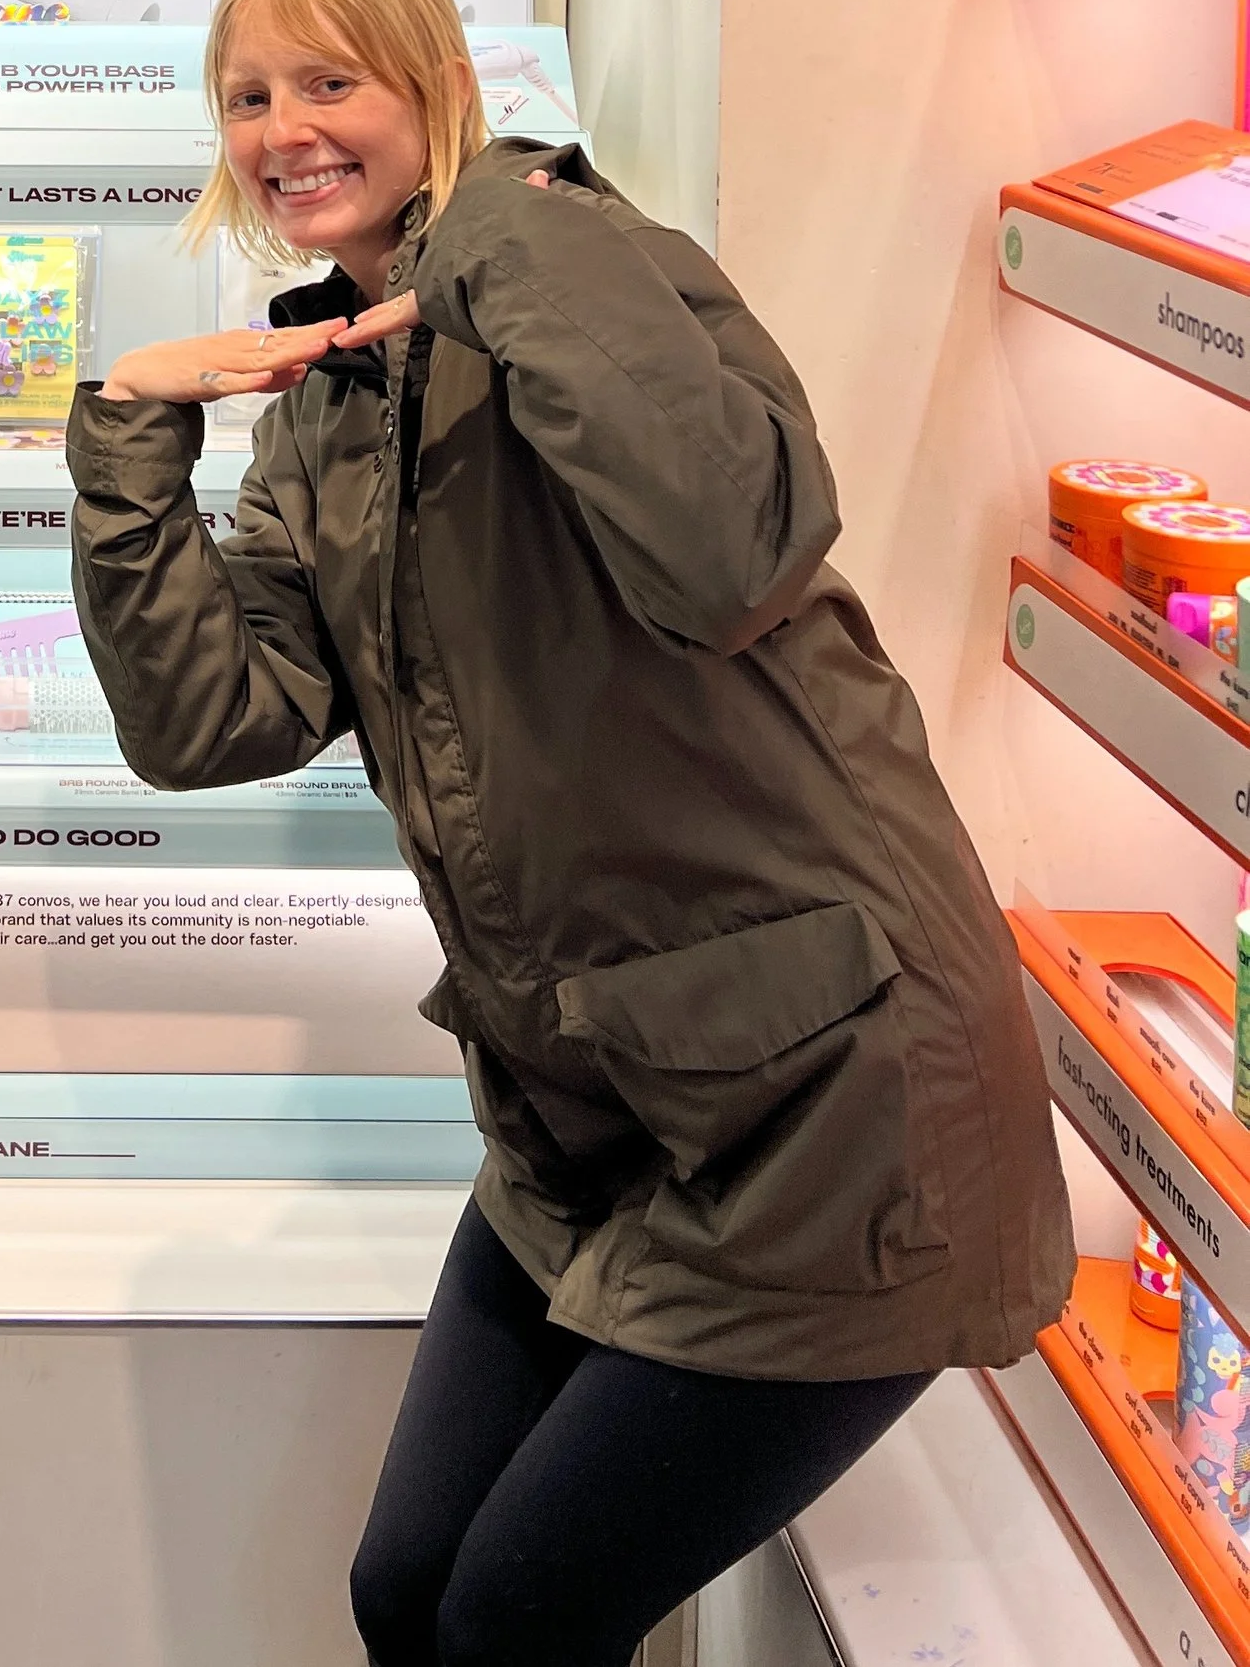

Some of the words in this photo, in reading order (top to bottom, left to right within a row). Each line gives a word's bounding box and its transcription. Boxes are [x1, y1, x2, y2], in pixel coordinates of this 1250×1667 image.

[24, 64, 99, 78] YOUR
[104, 65, 175, 78] BASE
[6, 80, 104, 93] POWER
[110, 81, 134, 93] IT
[138, 81, 176, 94] UP
[8, 187, 97, 203] LASTS
[101, 187, 123, 203] A
[1158, 292, 1247, 360] shampoos
[13, 829, 60, 846] DO
[66, 829, 161, 847] GOOD
[18, 893, 75, 909] convos,
[78, 896, 101, 908] we
[105, 893, 139, 908] hear
[143, 896, 171, 911] you
[175, 893, 206, 908] loud
[211, 893, 239, 908] and
[243, 893, 285, 908] clear.
[39, 912, 72, 926] that
[75, 912, 124, 927] values
[128, 913, 147, 927] its
[151, 913, 234, 930] community
[238, 913, 250, 927] is
[254, 913, 369, 930] non-negotiable.
[1057, 1034, 1132, 1157] fast-acting
[1135, 1133, 1222, 1259] treatments
